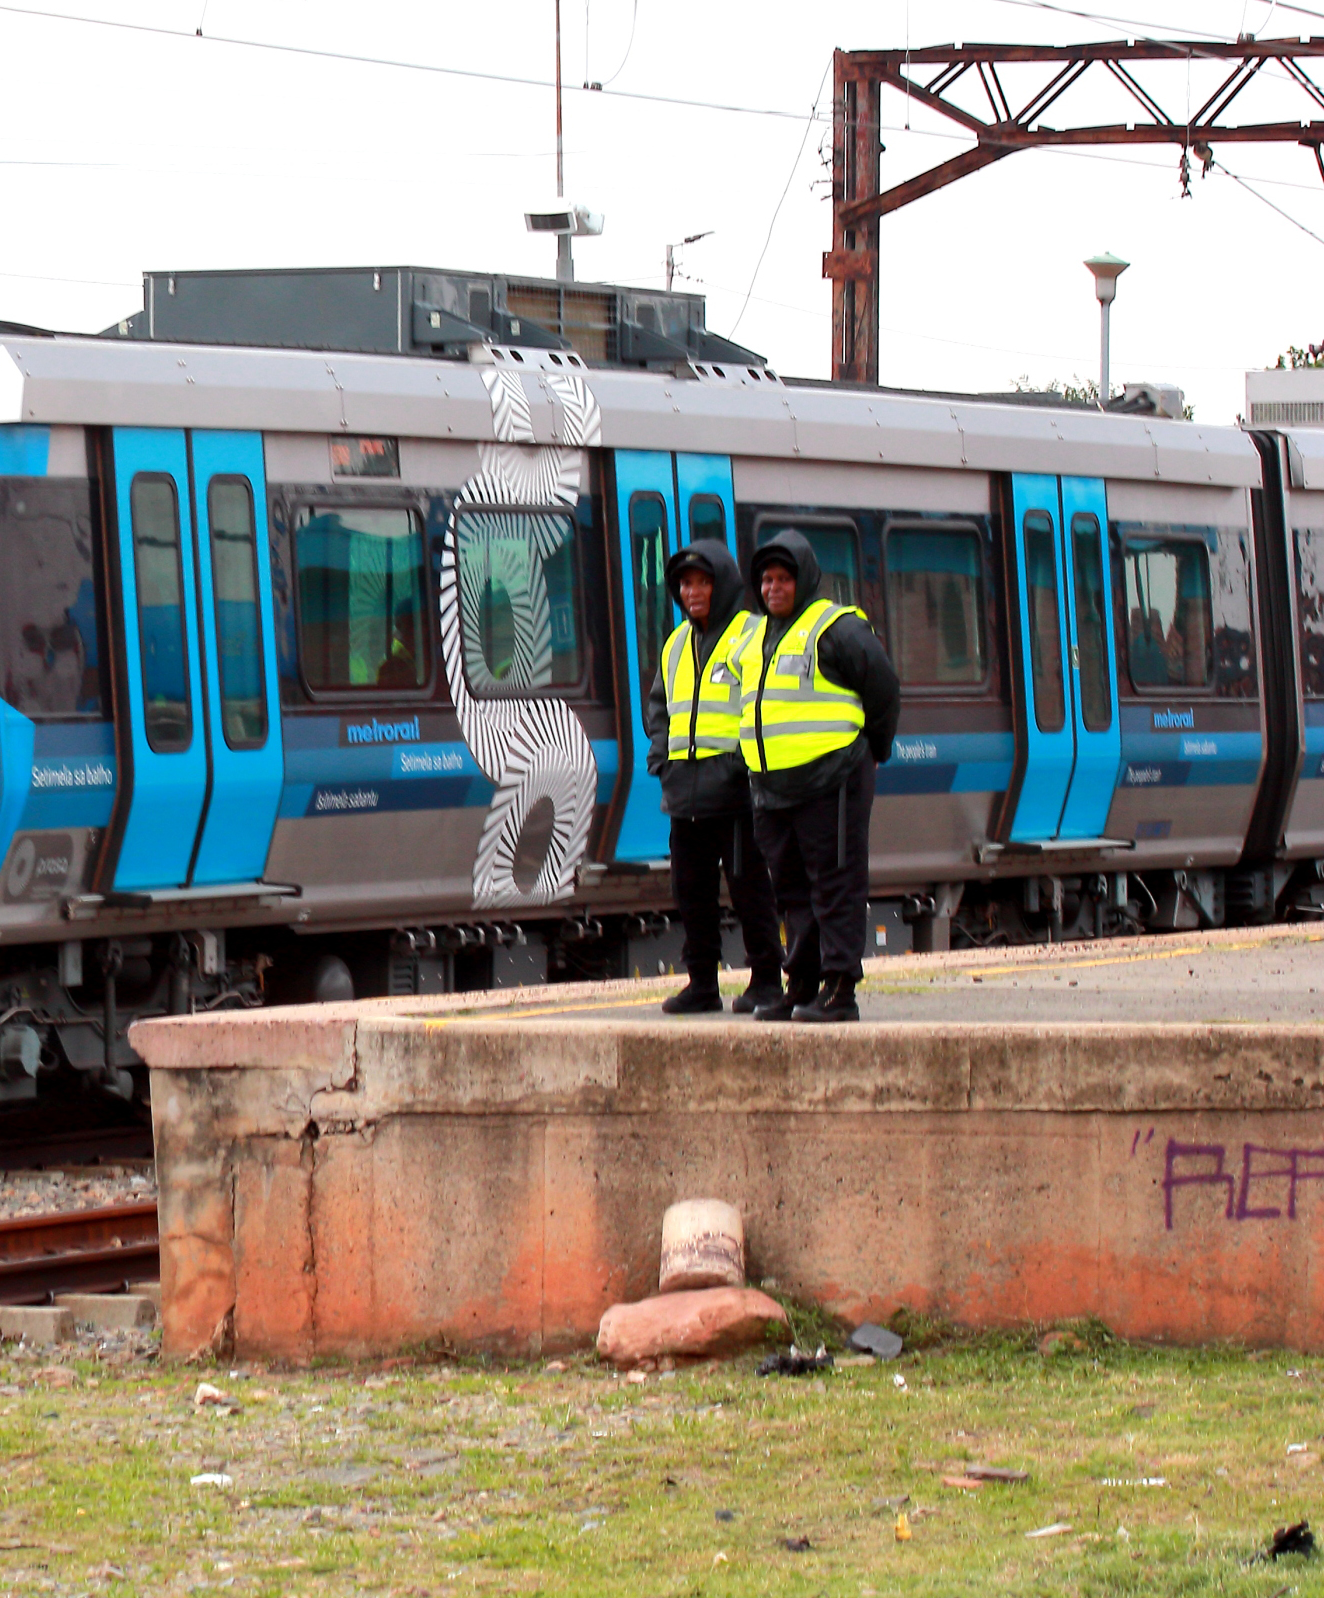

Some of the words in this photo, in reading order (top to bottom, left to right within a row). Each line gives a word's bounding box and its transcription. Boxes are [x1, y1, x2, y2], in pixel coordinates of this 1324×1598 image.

[1153, 707, 1194, 728] metrorail
[347, 715, 420, 743] metrorail
[74, 768, 86, 786] sa
